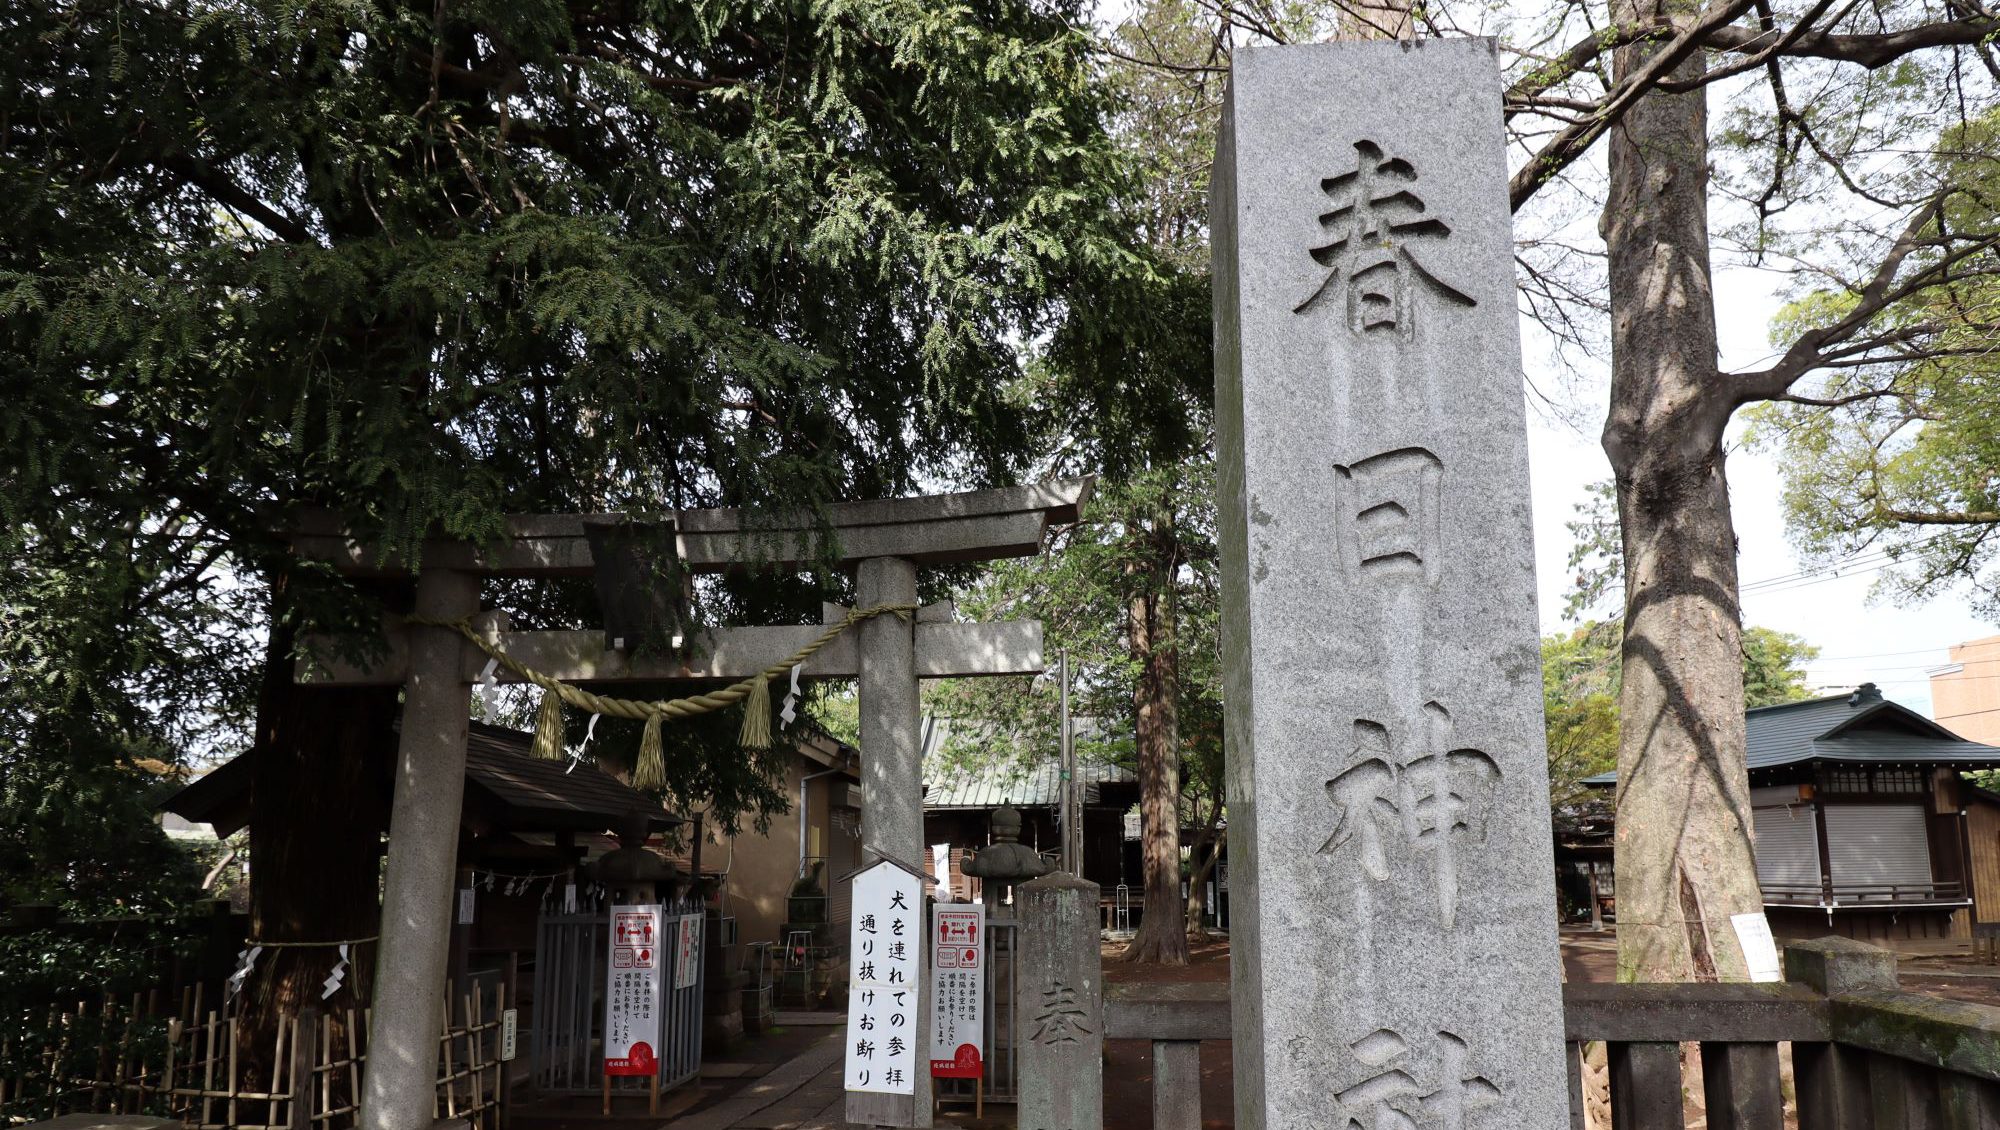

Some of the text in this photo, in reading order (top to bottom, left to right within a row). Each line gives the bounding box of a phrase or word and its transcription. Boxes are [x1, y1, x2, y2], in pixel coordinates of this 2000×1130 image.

[612, 973, 622, 1044] ご協力お願いします
[622, 973, 631, 1045] 順番にお参りください
[633, 973, 641, 1019] 間隔を空けて
[643, 973, 651, 1019] ご参拝の際は
[857, 915, 877, 1086] 通り抜けお断り
[886, 889, 909, 1087] 犬を連れての参拝
[937, 973, 946, 1047] ご協力お願いします
[947, 973, 956, 1047] 順番にお参りください
[958, 973, 966, 1021] 間隔を空けて
[968, 973, 976, 1021] ご参拝の際は
